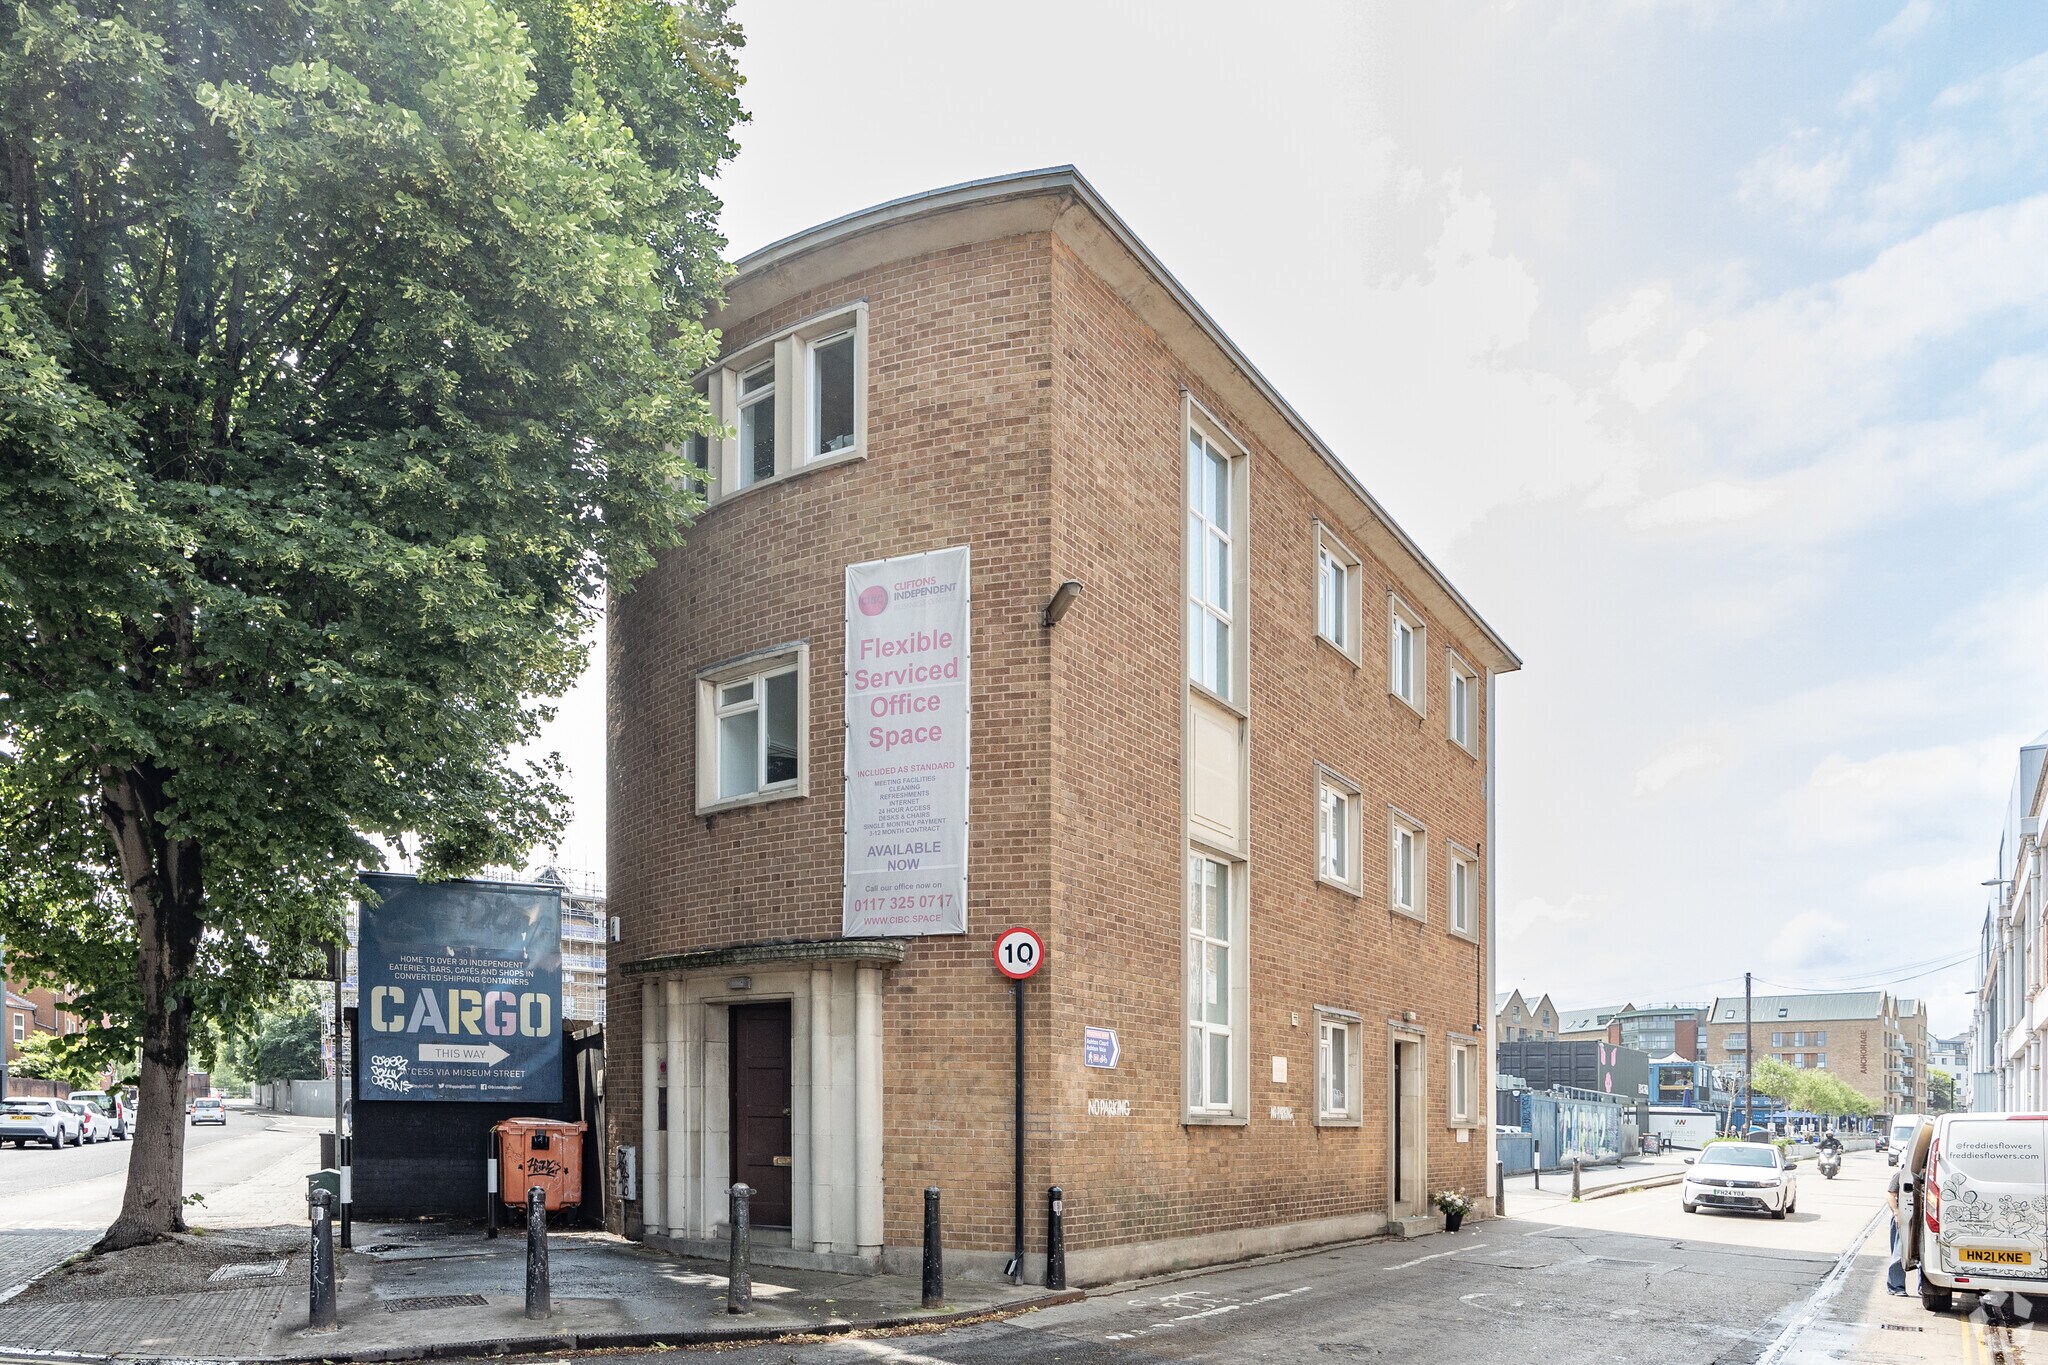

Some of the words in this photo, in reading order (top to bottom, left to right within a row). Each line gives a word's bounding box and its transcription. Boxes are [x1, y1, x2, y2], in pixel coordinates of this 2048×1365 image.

[894, 576, 936, 591] CLIFTONS
[894, 582, 957, 601] INDEPENDENT
[860, 629, 953, 660] Flexible
[854, 657, 958, 691] Serviced
[870, 693, 941, 718] Office
[869, 725, 942, 751] Space
[857, 766, 896, 778] INCLUDED
[898, 766, 908, 774] AS
[910, 761, 955, 772] STANDARD
[874, 778, 902, 786] MEETING
[902, 775, 936, 784] FACILITIES
[880, 790, 930, 800] REFRESHMENTS
[888, 784, 920, 792] CLEANING
[889, 798, 919, 806] INTERNET
[886, 806, 904, 814] HOUR
[864, 822, 885, 830] SINGLE
[886, 820, 916, 828] MONTHLY
[882, 827, 904, 835] MONTH
[906, 825, 941, 834] CONTRACT
[867, 841, 941, 858] AVAILABLE
[887, 858, 920, 872] NOW
[865, 885, 878, 893] Call
[894, 883, 914, 891] office
[854, 897, 885, 912] 0117
[890, 896, 914, 910] 325
[919, 894, 953, 909] 0717
[864, 914, 942, 925] WWW.CIBC.SPACE
[1004, 942, 1034, 964] 10
[400, 956, 423, 964] HOME
[437, 957, 457, 965] OVER
[459, 958, 467, 966] 30
[469, 959, 524, 969] INDEPENDENT
[389, 964, 428, 973] EATERIES,
[430, 966, 453, 974] BARS,
[455, 966, 479, 975] CAFÉS
[481, 968, 497, 976] AND
[499, 969, 524, 977] SHOPS
[526, 970, 534, 978] IN
[394, 972, 441, 981] CONVERTED
[443, 975, 479, 983] SHIPPING
[481, 977, 529, 986] CONTAINERS
[371, 986, 551, 1038] CARGO
[435, 1048, 460, 1058] THIS
[463, 1049, 486, 1059] WAY
[1860, 1029, 1869, 1075] ANCHORAGE
[452, 1069, 491, 1077] MUSEUM
[493, 1070, 525, 1078] STREET
[1088, 1099, 1099, 1116] NO
[1100, 1099, 1131, 1116] PARKING
[1955, 1141, 2032, 1151] @freddiesflowers
[1949, 1151, 2039, 1161] freddiesflowers.com
[1966, 1250, 1994, 1262] HN21
[1998, 1252, 2023, 1262] KNE
